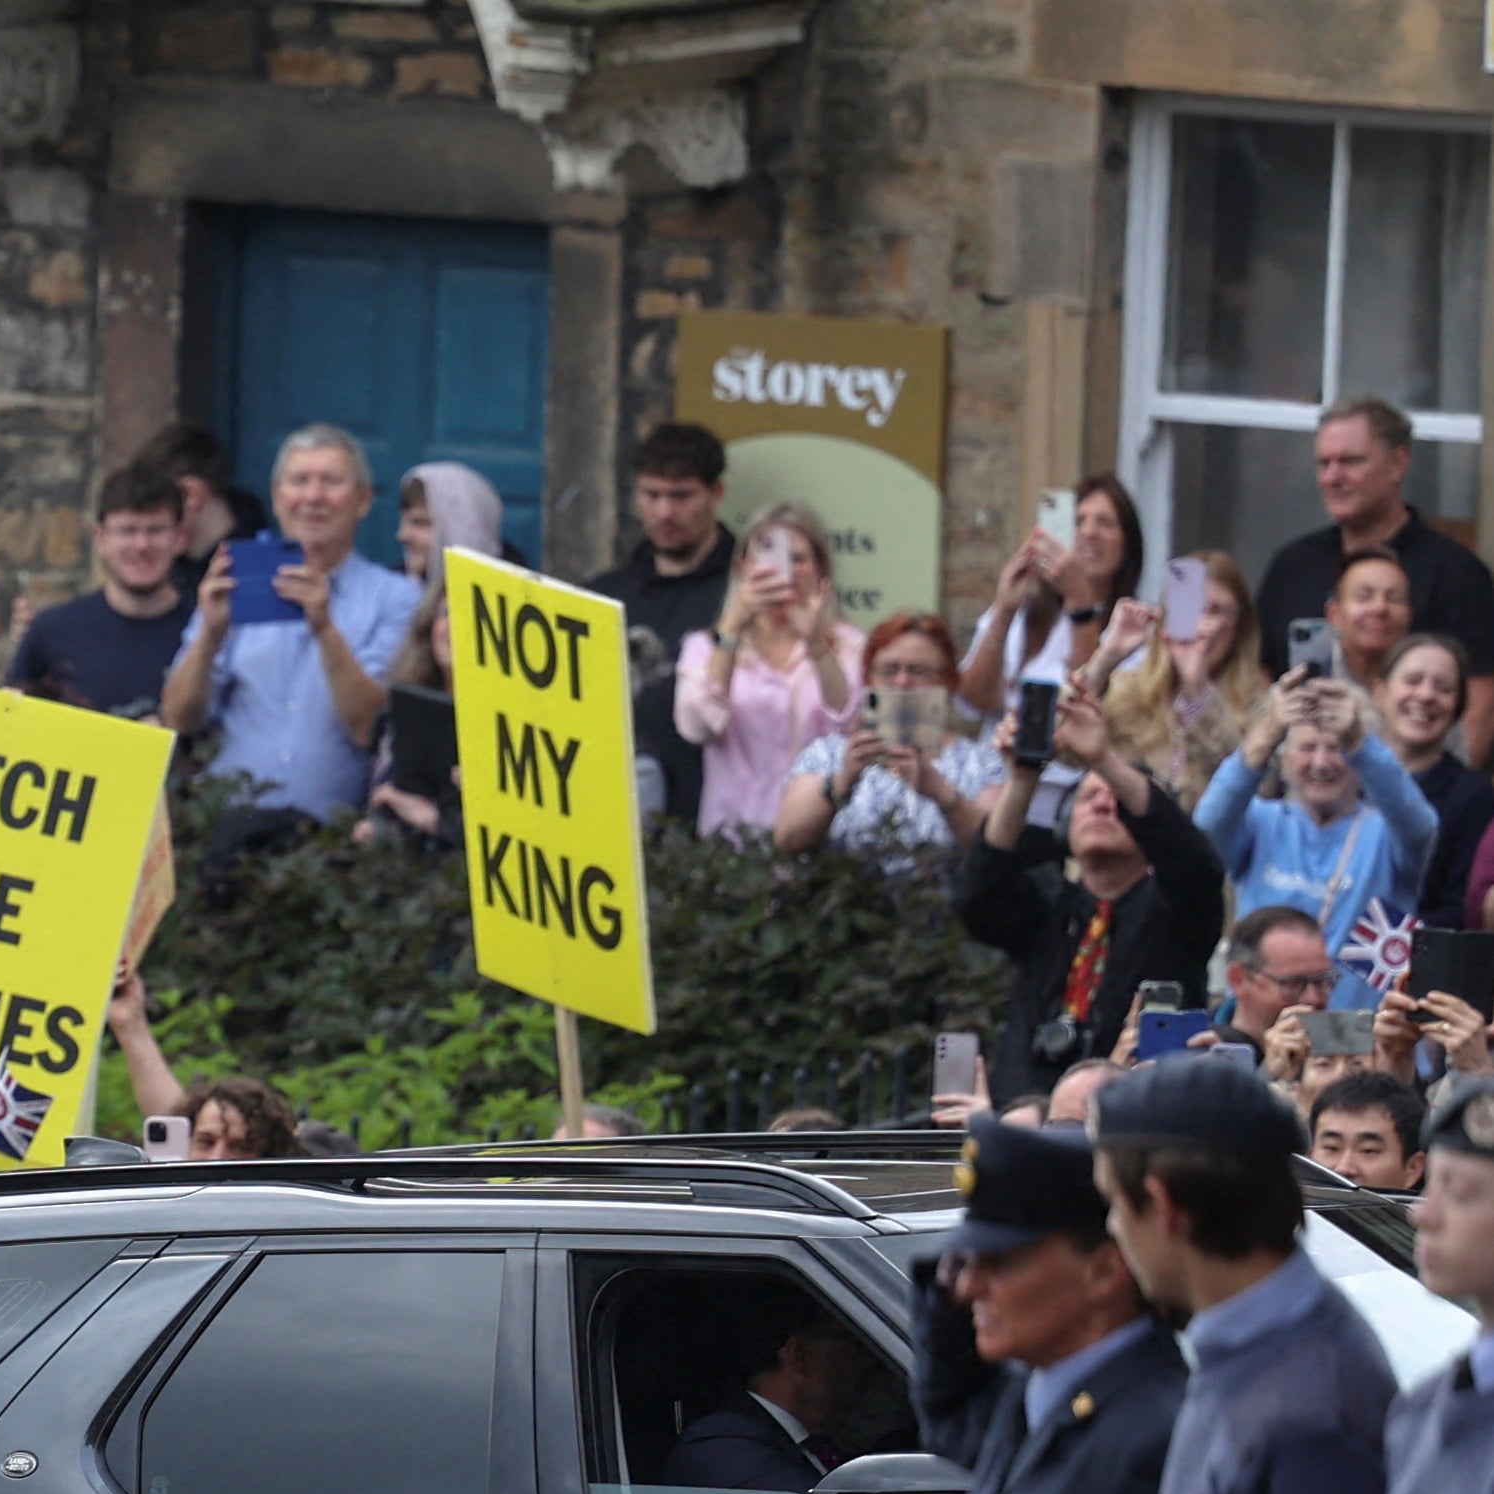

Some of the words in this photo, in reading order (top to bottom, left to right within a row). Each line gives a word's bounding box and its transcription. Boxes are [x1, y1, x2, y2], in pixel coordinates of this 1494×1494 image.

[713, 350, 907, 429] storey
[472, 583, 590, 702] NOT
[495, 711, 582, 818] MY
[478, 823, 623, 953] KING
